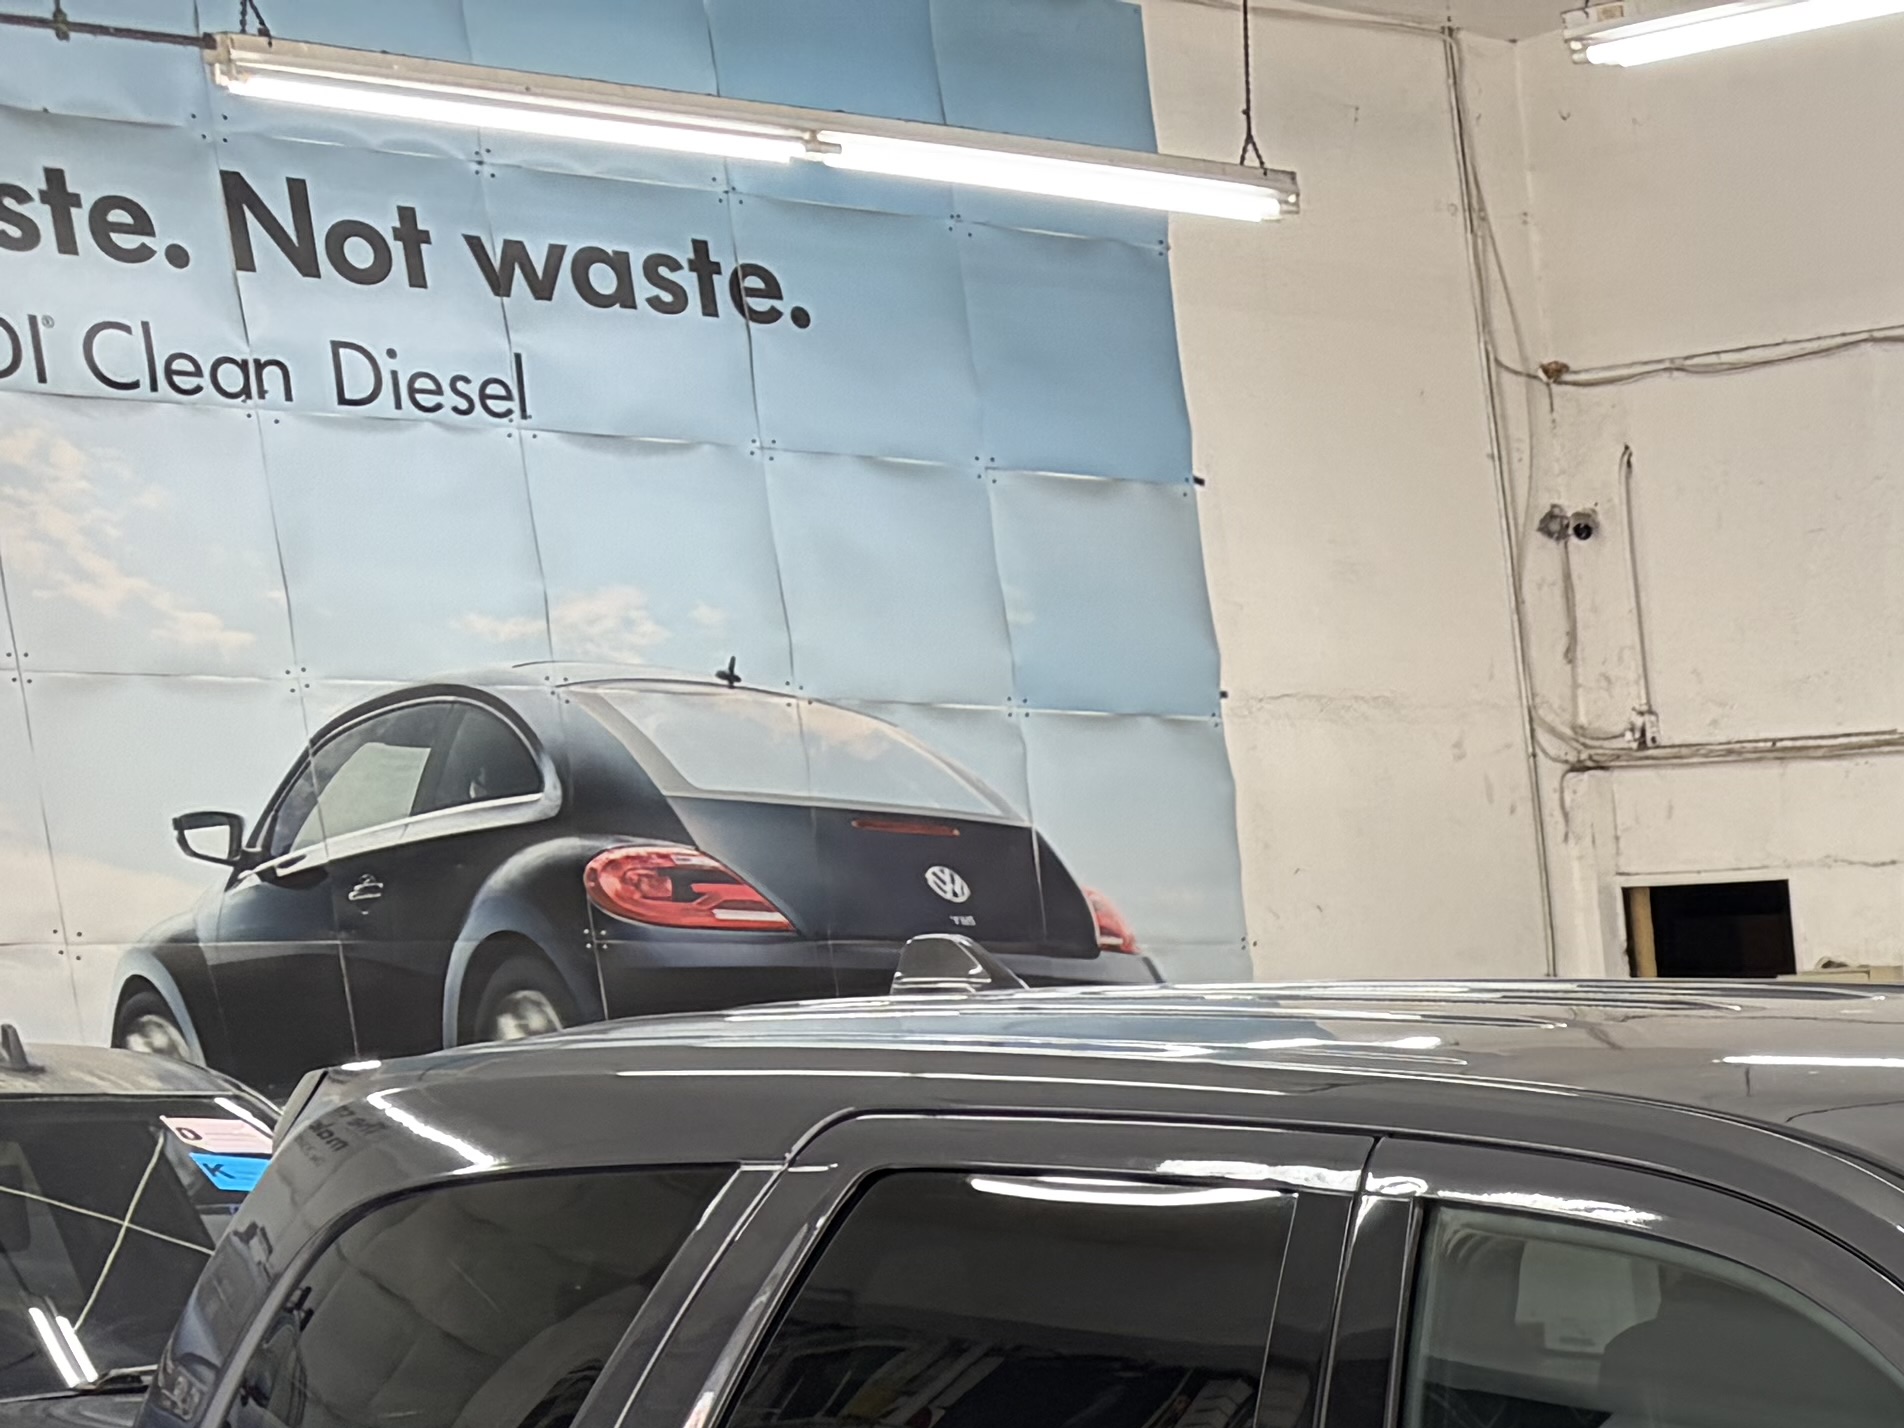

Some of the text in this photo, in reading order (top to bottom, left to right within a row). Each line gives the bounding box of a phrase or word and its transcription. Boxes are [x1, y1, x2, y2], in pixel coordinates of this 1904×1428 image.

[219, 169, 432, 289] Not
[461, 233, 811, 329] waste.
[82, 320, 293, 402] Clean
[330, 339, 527, 420] Diesel
